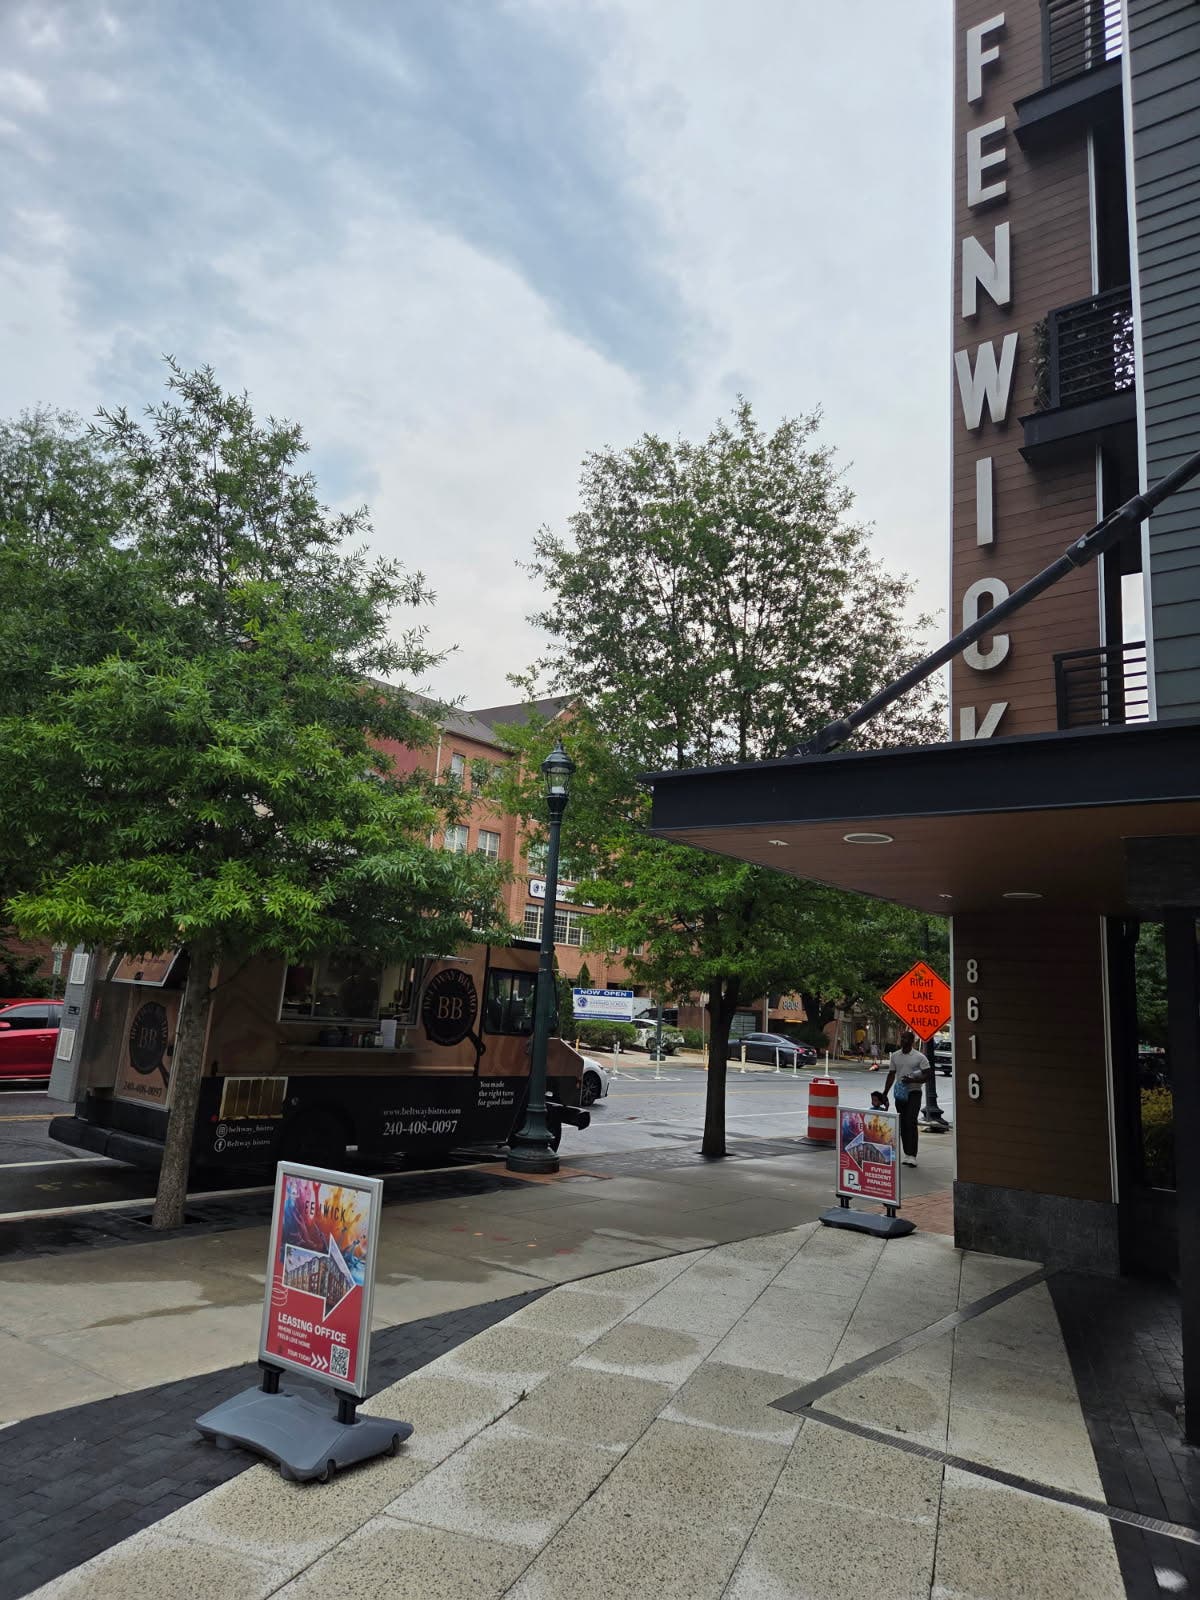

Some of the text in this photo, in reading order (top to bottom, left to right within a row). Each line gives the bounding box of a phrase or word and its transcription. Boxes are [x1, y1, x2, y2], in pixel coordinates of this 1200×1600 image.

[910, 977, 934, 987] RIGHT
[912, 991, 934, 1000] LANE
[438, 996, 463, 1020] BB
[907, 1003, 940, 1014] CLOSED
[910, 1017, 939, 1027] AHEAD
[966, 958, 979, 1099] 8616
[488, 1090, 502, 1098] right
[487, 1099, 500, 1108] good
[383, 1106, 461, 1117] www.beltwaybistro.com
[382, 1120, 458, 1136] 240-408-0097
[871, 1167, 892, 1175] FUTURE
[848, 1173, 855, 1184] P
[864, 1172, 892, 1181] RESIDENT
[866, 1178, 892, 1187] PARKING
[277, 1325, 308, 1339] WHERE LUXURY
[278, 1312, 347, 1344] LEASING OFFICE
